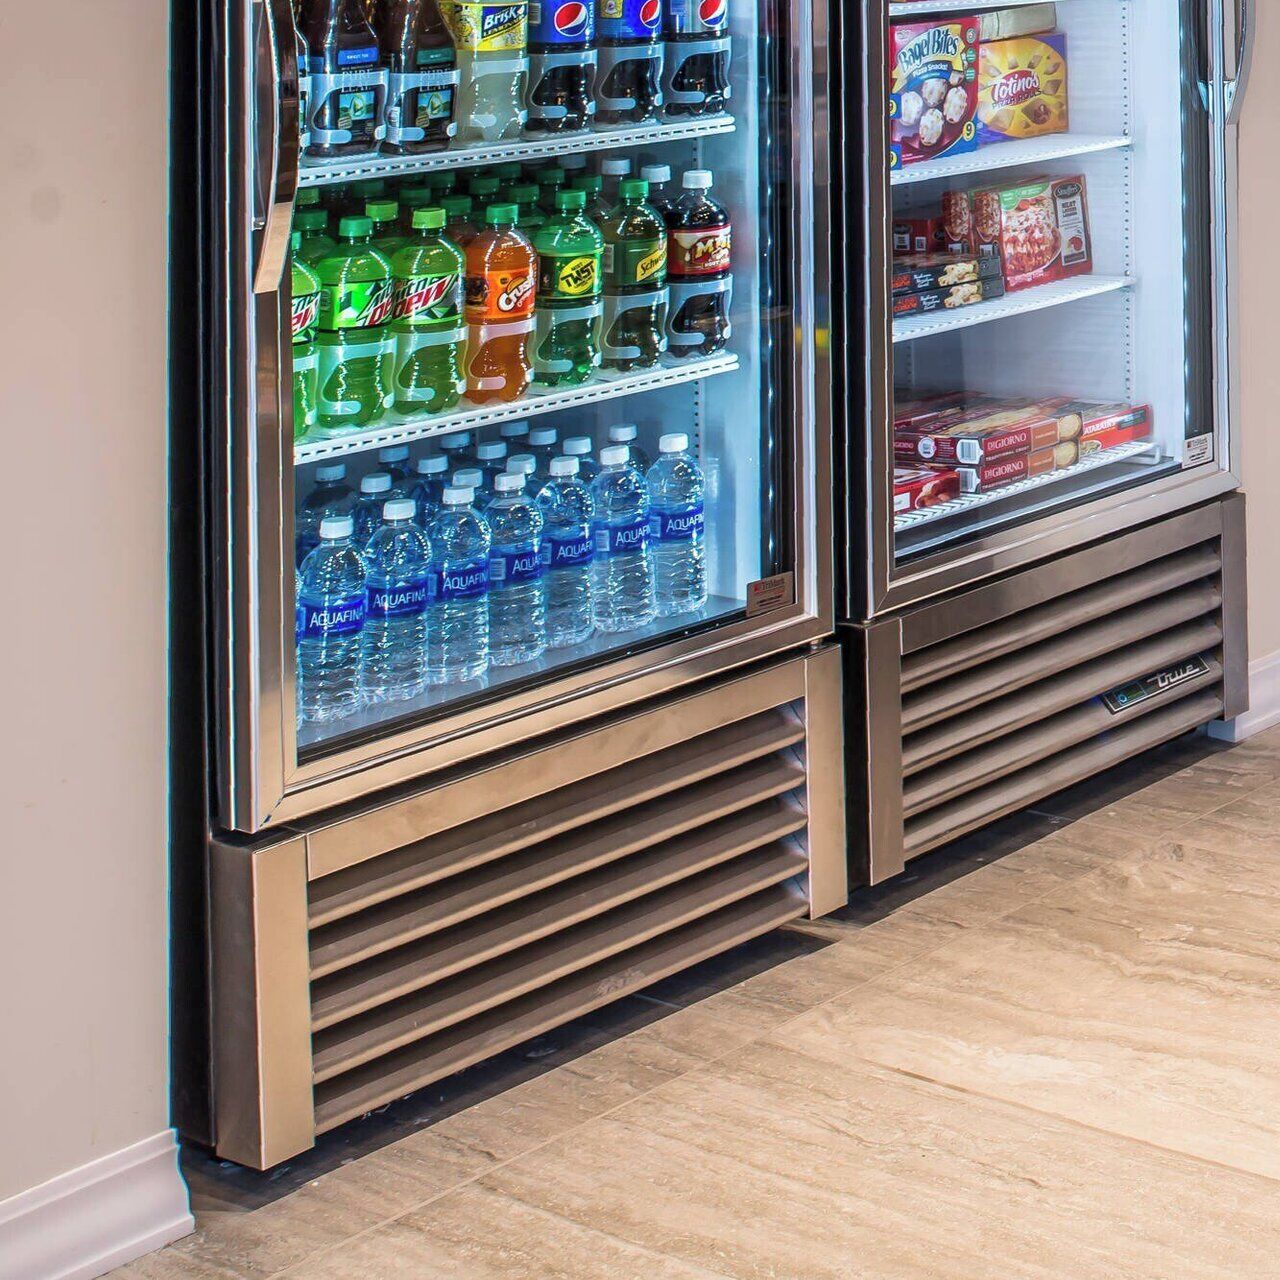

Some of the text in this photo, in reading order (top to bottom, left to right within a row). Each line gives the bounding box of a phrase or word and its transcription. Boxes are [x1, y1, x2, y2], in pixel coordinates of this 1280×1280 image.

[899, 28, 959, 70] Bagel Bites
[966, 124, 974, 136] 9
[498, 273, 537, 311] Crush
[372, 588, 426, 609] AQUAFINA
[309, 607, 363, 628] AQUAFINA
[1147, 665, 1200, 688] true
